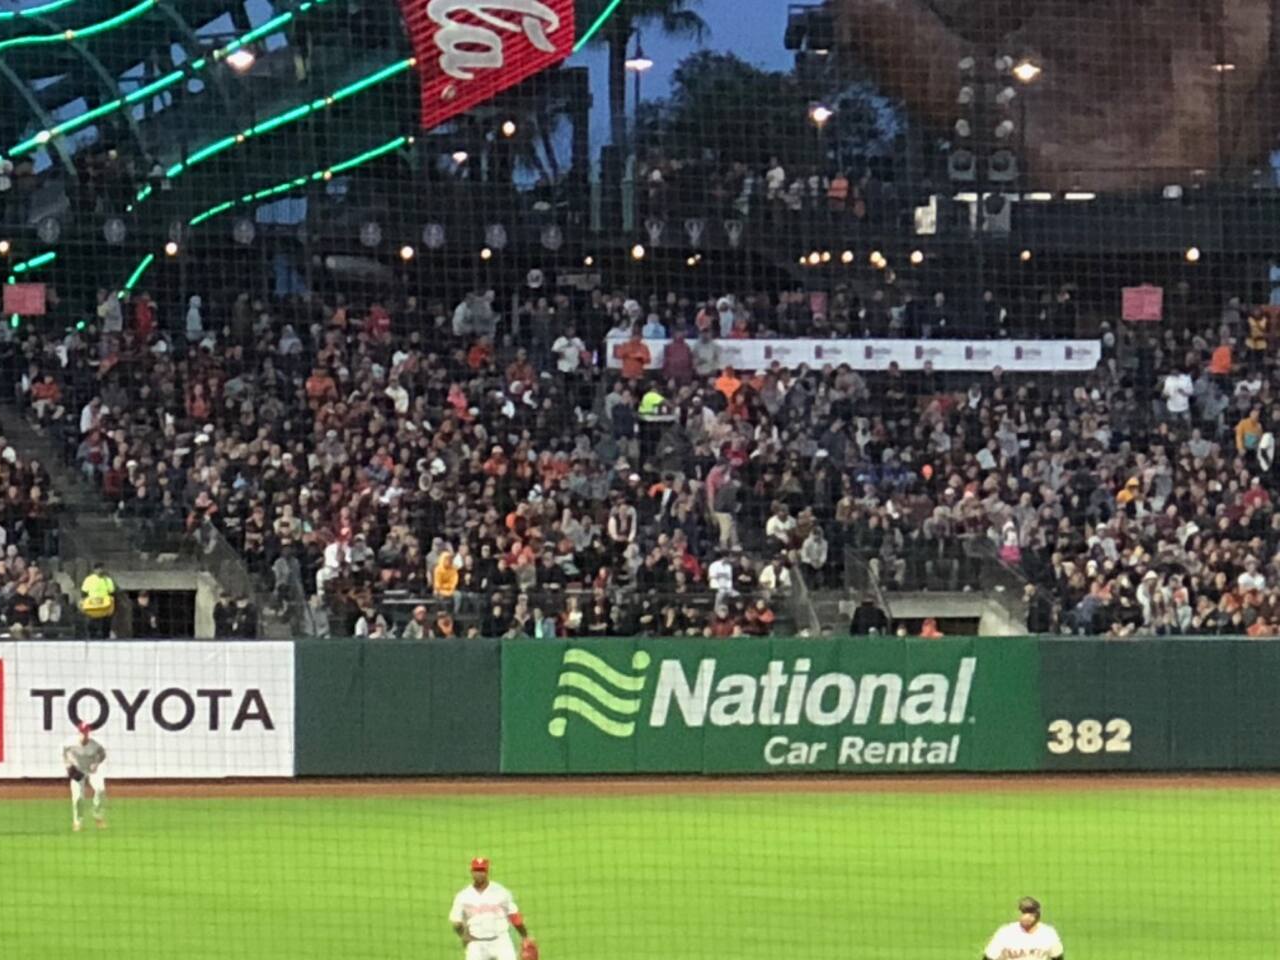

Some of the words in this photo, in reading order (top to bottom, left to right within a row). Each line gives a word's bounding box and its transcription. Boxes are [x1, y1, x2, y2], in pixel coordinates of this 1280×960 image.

[30, 688, 275, 732] TOYOTA
[649, 657, 976, 727] National
[764, 736, 826, 764] Car
[838, 735, 960, 764] Rental
[1047, 719, 1132, 753] 382
